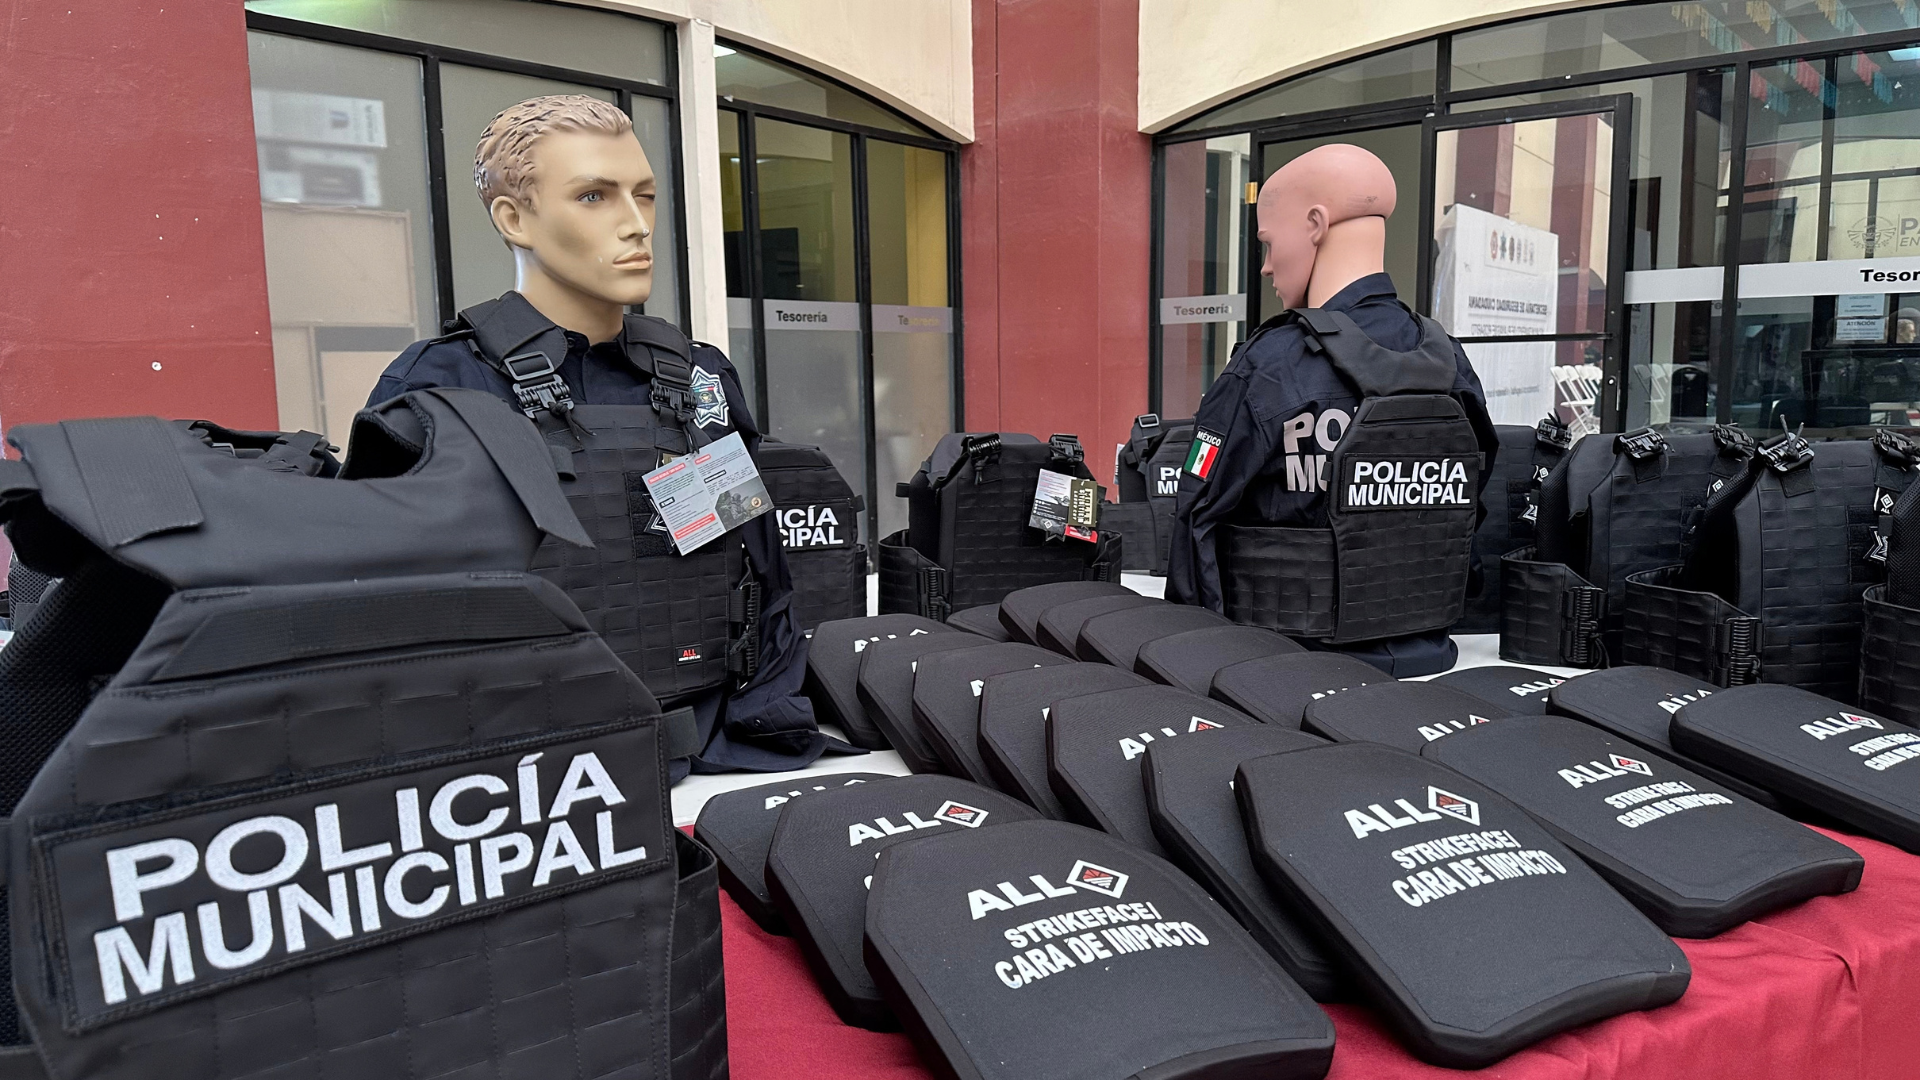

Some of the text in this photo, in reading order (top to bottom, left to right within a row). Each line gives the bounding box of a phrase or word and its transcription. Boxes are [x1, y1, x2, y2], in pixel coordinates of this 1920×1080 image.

[776, 310, 827, 323] Tesorería
[1173, 304, 1232, 316] Tesorería
[1196, 430, 1221, 447] MÉXICO
[1353, 459, 1468, 483] POLICÍA
[1348, 482, 1471, 506] MUNICIPAL
[776, 505, 839, 529] ICÍA
[683, 649, 696, 657] ALL
[1800, 717, 1862, 740] ALL
[1557, 761, 1628, 789] ALL
[1343, 798, 1442, 839] ALL
[1616, 793, 1734, 828] CARA DE IMPACTO
[107, 752, 627, 923] POLICÍA
[849, 811, 942, 847] ALL
[1392, 849, 1567, 908] CARA DE IMPACTO
[94, 811, 647, 1005] MUNICIPAL
[967, 874, 1078, 921] ALL
[994, 921, 1210, 989] CARA DE IMPACTO
